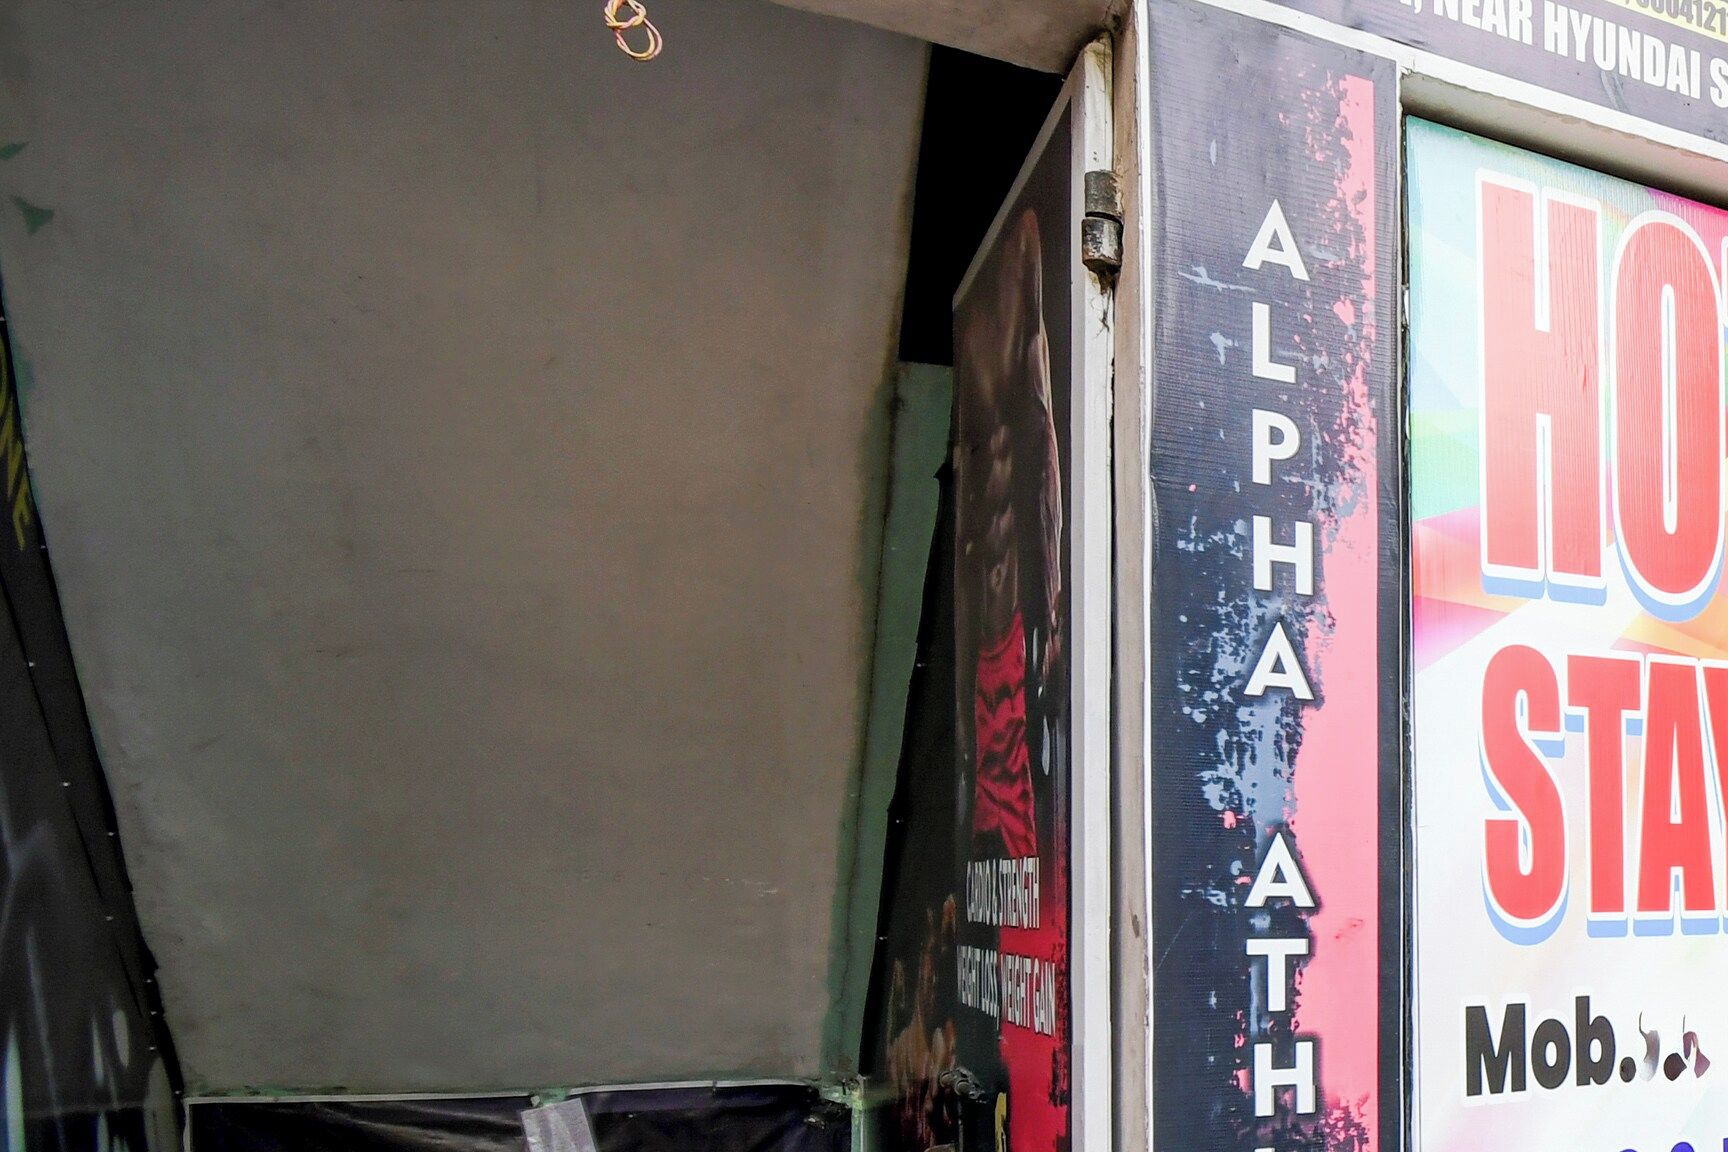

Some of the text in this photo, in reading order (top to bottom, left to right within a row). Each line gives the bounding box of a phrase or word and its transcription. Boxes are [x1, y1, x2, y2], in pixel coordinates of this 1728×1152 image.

[1544, 0, 1700, 99] HYUNDAI
[1242, 199, 1315, 701] ALPHA
[966, 859, 991, 926] CARDIO
[999, 856, 1040, 929] STRENGTH
[957, 945, 981, 1009] WEIGHT
[1000, 953, 1032, 1028] WEIGHT
[1033, 957, 1056, 1038] GAIN
[1465, 995, 1637, 1097] Mob.
